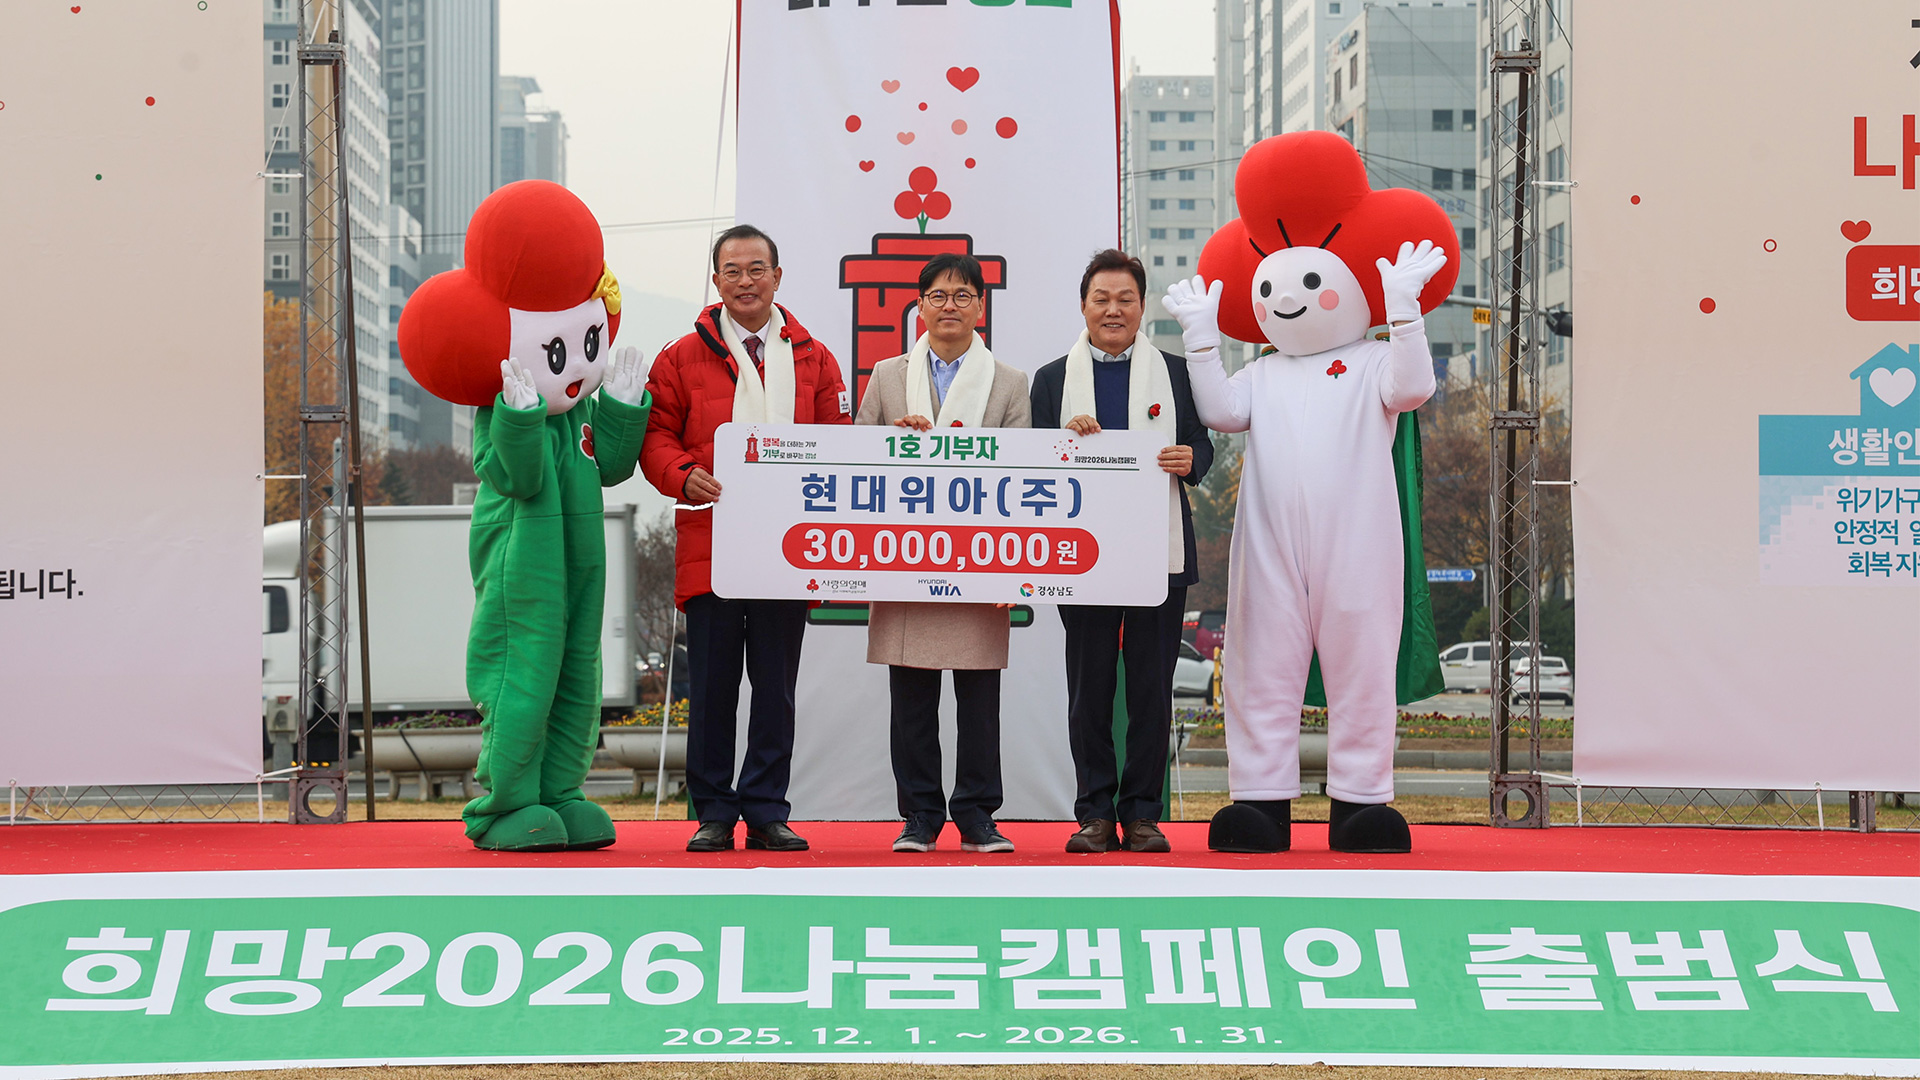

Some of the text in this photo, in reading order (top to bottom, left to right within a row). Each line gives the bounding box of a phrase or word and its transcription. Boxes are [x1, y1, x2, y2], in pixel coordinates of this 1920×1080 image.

[885, 434, 999, 461] 1호 기부자
[1834, 518, 1899, 546] 안정적
[1848, 550, 1893, 578] 회복
[929, 583, 962, 597] WIA
[1037, 585, 1074, 597] 경상남도
[45, 925, 1900, 1016] 희망2026나눔캠페인 출범식
[662, 1026, 793, 1046] 2025.
[811, 1026, 872, 1045] 12.
[905, 1026, 937, 1045] 1.
[1005, 1026, 1139, 1044] 2026.
[1169, 1026, 1203, 1044] 1.
[1220, 1026, 1283, 1044] 31.
